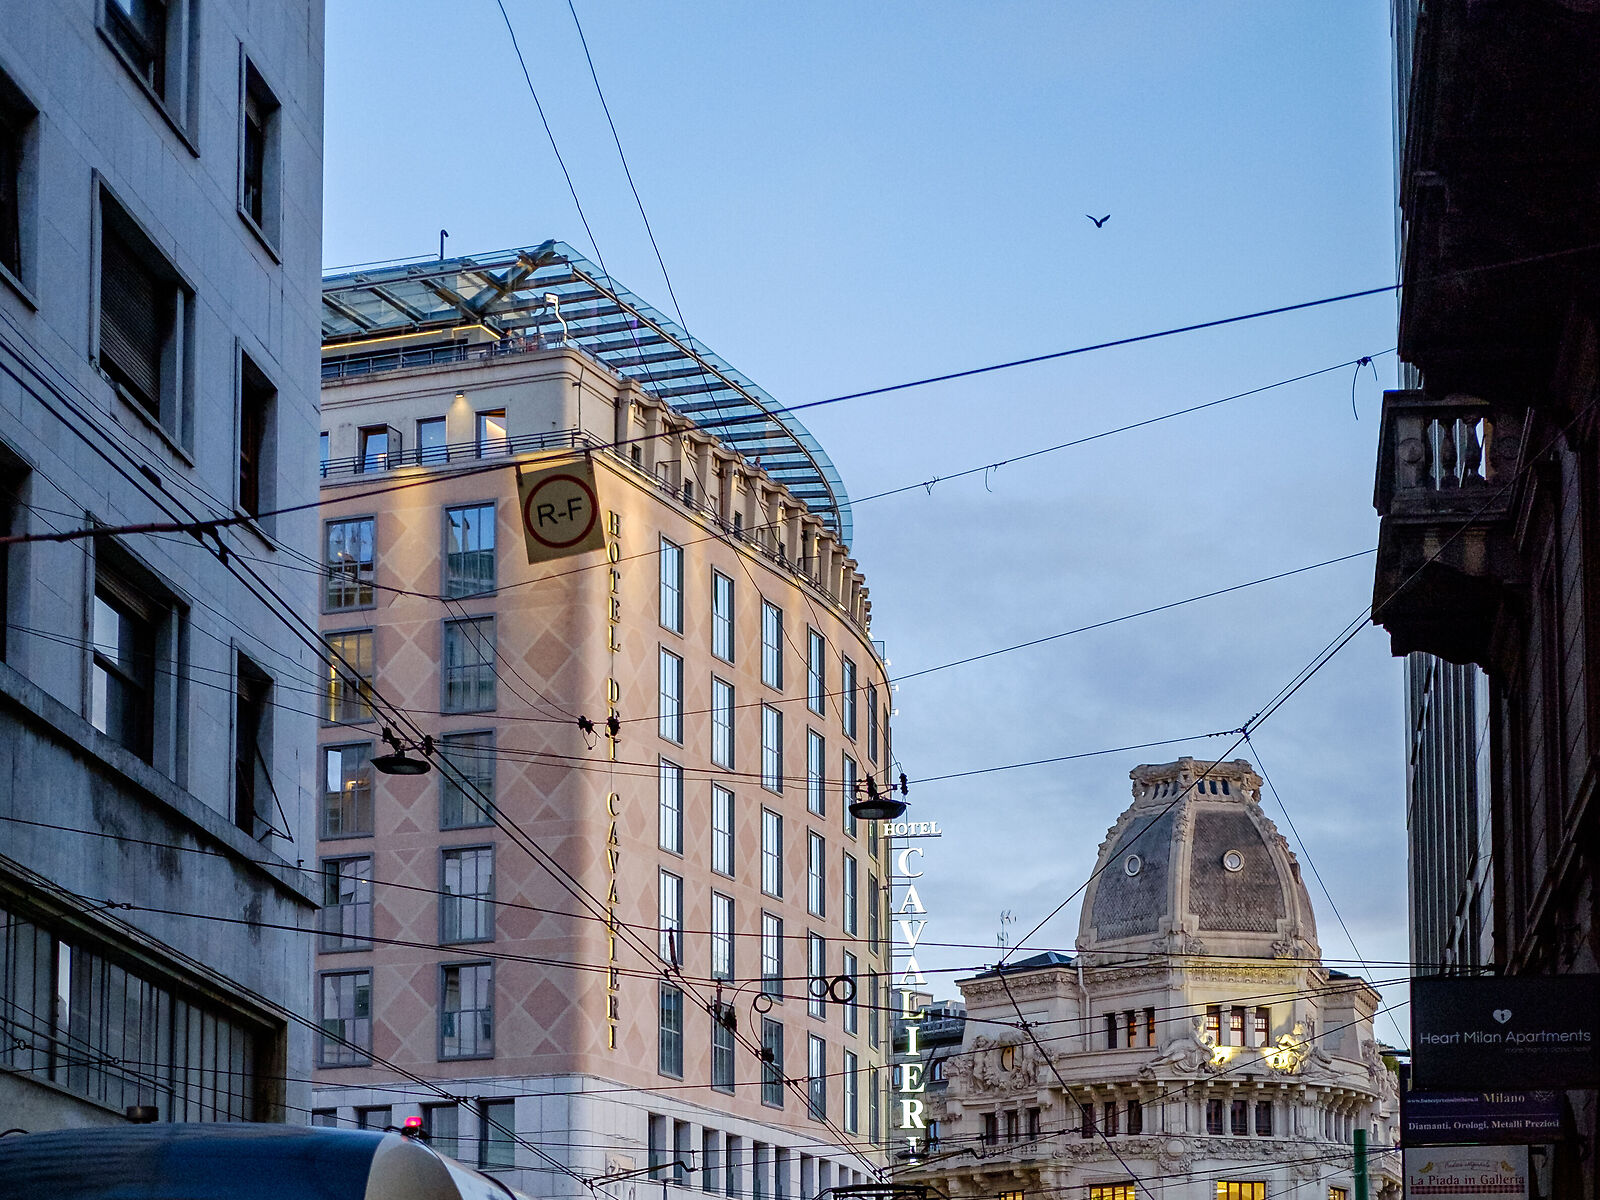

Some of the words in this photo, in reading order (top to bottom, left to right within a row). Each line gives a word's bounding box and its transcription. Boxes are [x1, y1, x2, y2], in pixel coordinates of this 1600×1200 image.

[536, 497, 583, 528] R-F
[607, 510, 622, 653] HOTEL
[882, 821, 942, 837] HOTEL
[606, 791, 621, 1051] CAVALIERI
[897, 847, 929, 1167] CAVALIERI
[1420, 1031, 1460, 1045] Heart
[1463, 1030, 1501, 1043] Milan
[1505, 1028, 1592, 1046] Apartments
[1482, 1092, 1526, 1104] Milano
[1491, 1119, 1523, 1129] Metalli
[1525, 1118, 1560, 1128] Preziosi
[1410, 1175, 1424, 1186] La
[1428, 1174, 1460, 1186] Piada
[1464, 1174, 1476, 1185] in
[1480, 1173, 1525, 1185] Galleria
